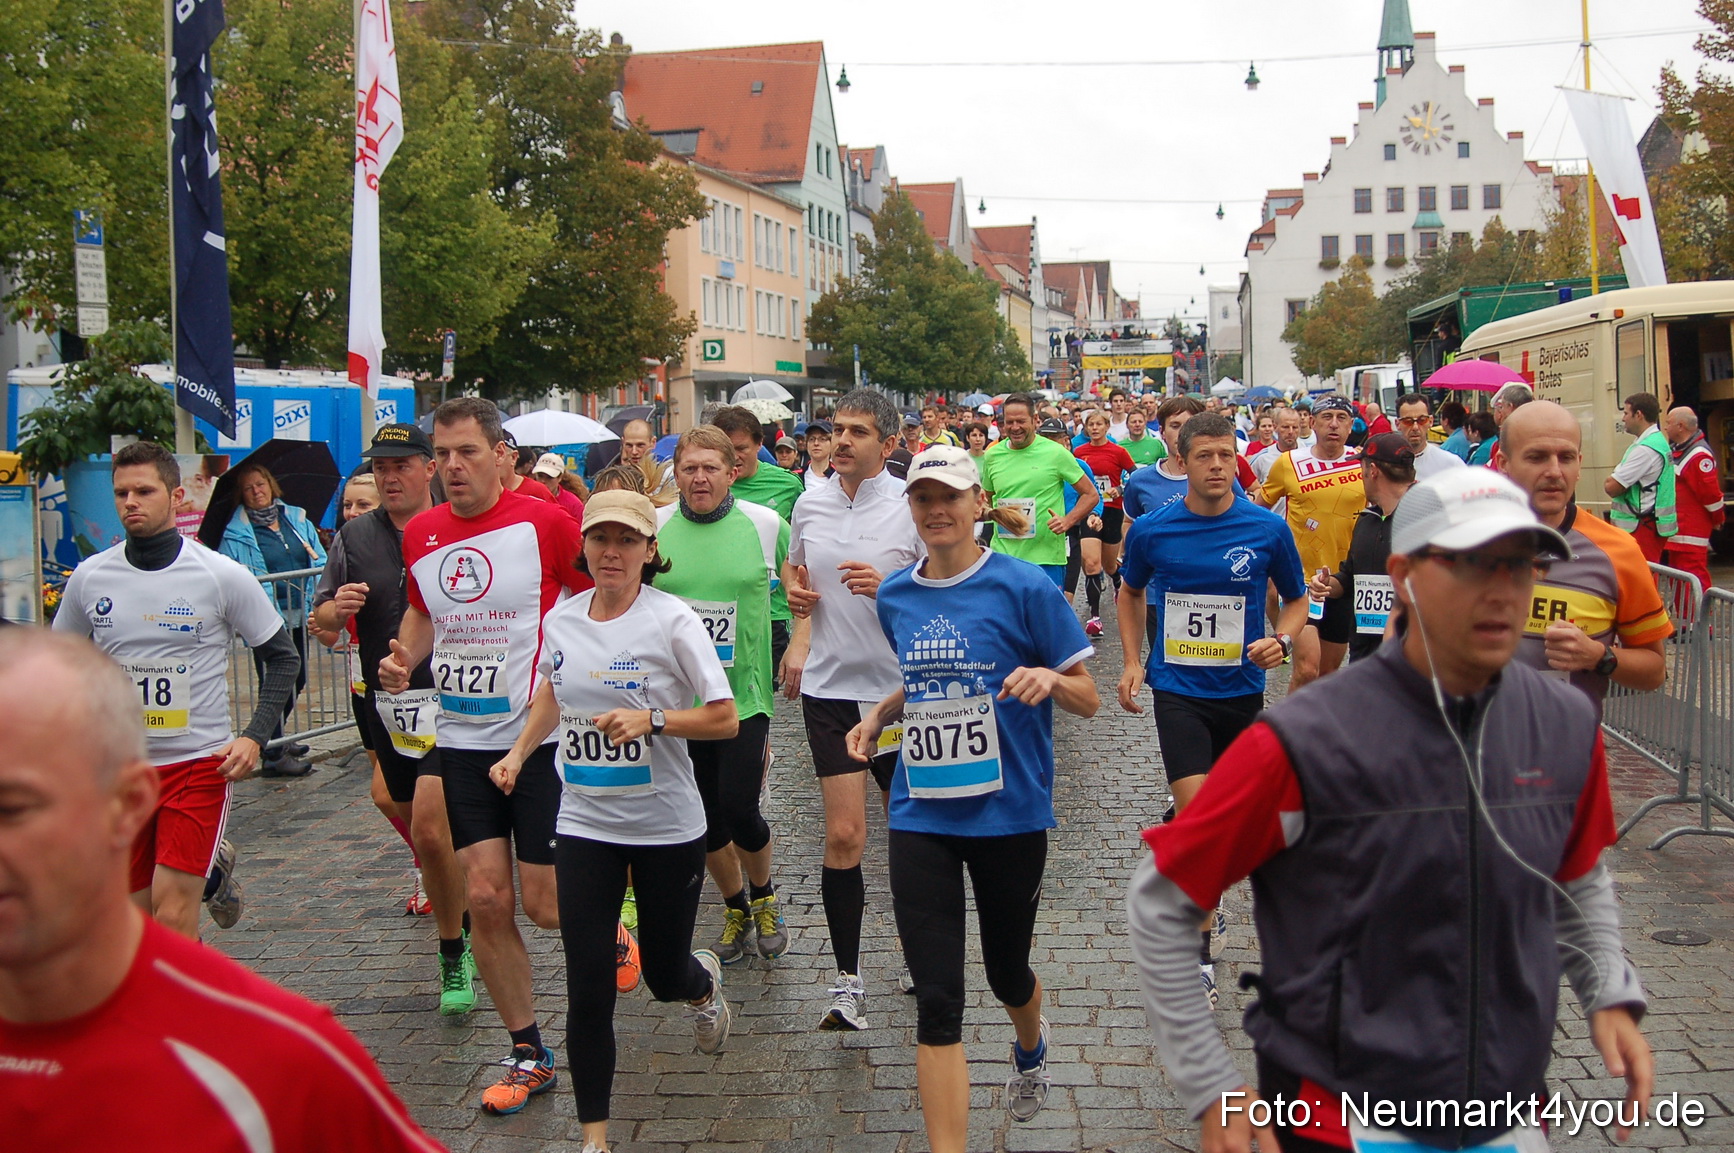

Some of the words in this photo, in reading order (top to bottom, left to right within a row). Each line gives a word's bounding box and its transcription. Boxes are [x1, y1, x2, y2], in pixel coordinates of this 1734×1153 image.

[705, 341, 722, 358] D
[1539, 340, 1589, 368] Bayerisches
[1112, 357, 1143, 366] START
[1539, 370, 1563, 389] Rotes
[1300, 479, 1335, 494] MAX
[1166, 599, 1191, 608] PARTL
[1193, 602, 1231, 610] Neumarkt
[1356, 589, 1395, 611] 2635
[434, 614, 461, 624] AUFEN
[465, 612, 484, 621] MIT
[489, 609, 517, 620] HERZ
[691, 606, 726, 615] Neumarkt
[1530, 596, 1575, 623] ER.
[93, 616, 113, 624] PARTL
[1187, 612, 1217, 638] 51
[1361, 616, 1382, 626] Markus
[482, 625, 508, 633] Röschl
[440, 636, 509, 646] eistungsdiagnostik
[434, 651, 458, 660] PARTL
[458, 652, 495, 661] Neumarkt
[1178, 643, 1225, 657] Christian
[120, 664, 131, 672] TL
[131, 664, 173, 673] Neumarkt
[904, 661, 952, 672] Neumarkter
[953, 661, 996, 670] Stadtlauf
[437, 663, 499, 693] 2127
[137, 676, 172, 706] 18
[395, 696, 429, 705] Neumarkt
[458, 700, 481, 712] Willi
[393, 706, 420, 732] 57
[560, 714, 585, 726] PARTL
[902, 711, 925, 721] ARTL
[925, 707, 974, 720] Neumarkt
[400, 735, 427, 749] Thomas
[565, 729, 641, 762] 3096
[907, 720, 988, 762] 3075
